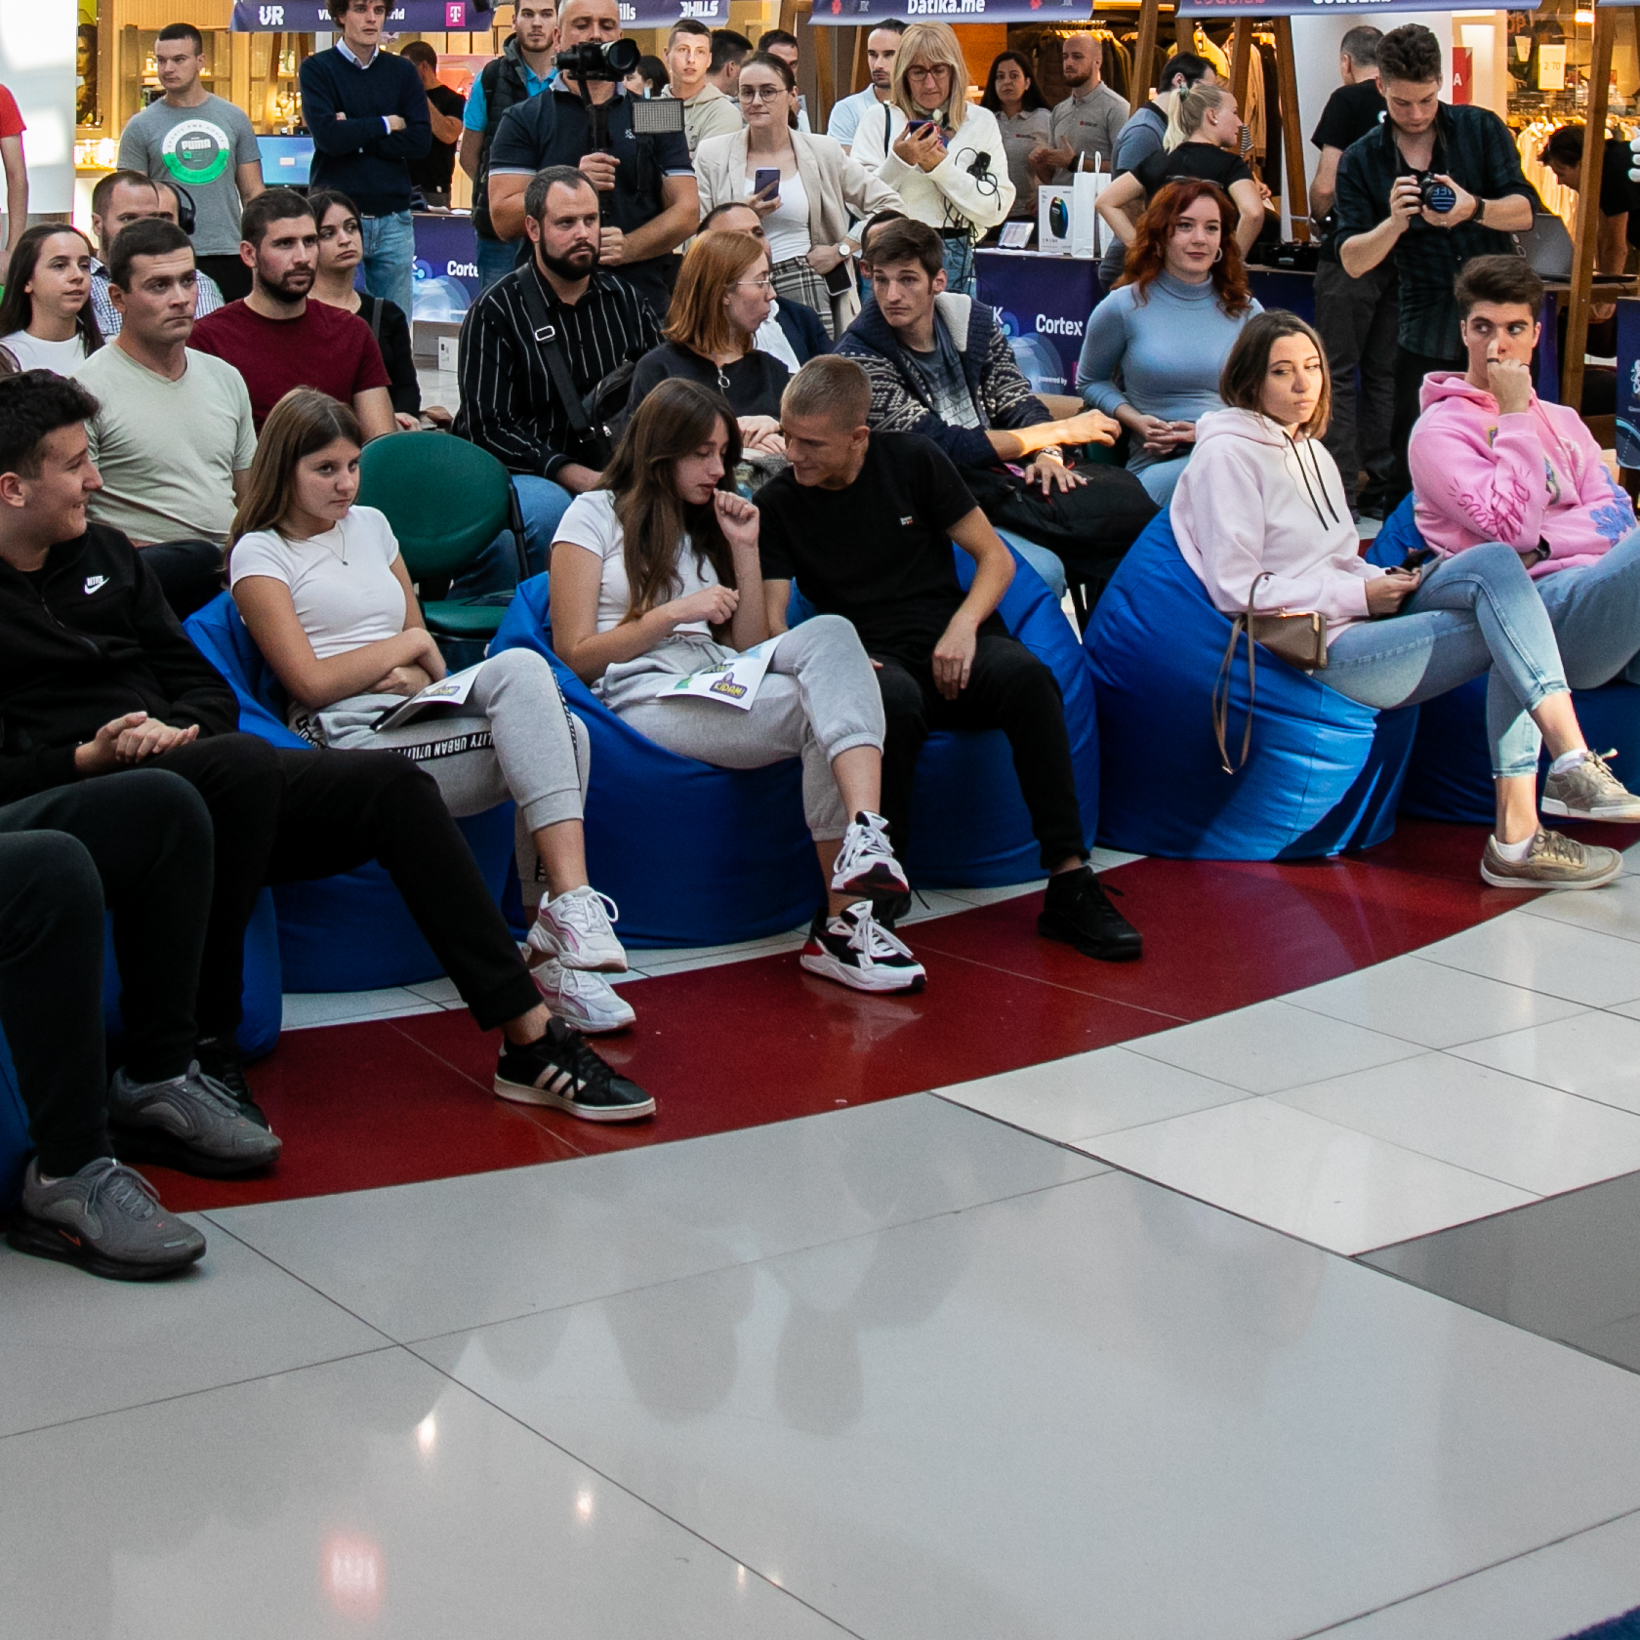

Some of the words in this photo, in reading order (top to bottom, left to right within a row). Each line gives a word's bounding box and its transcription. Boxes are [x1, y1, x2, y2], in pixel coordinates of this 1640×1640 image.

[181, 139, 211, 150] PUMA
[1035, 314, 1083, 336] Cortex
[87, 575, 104, 586] NIKE
[434, 736, 467, 756] URBAN
